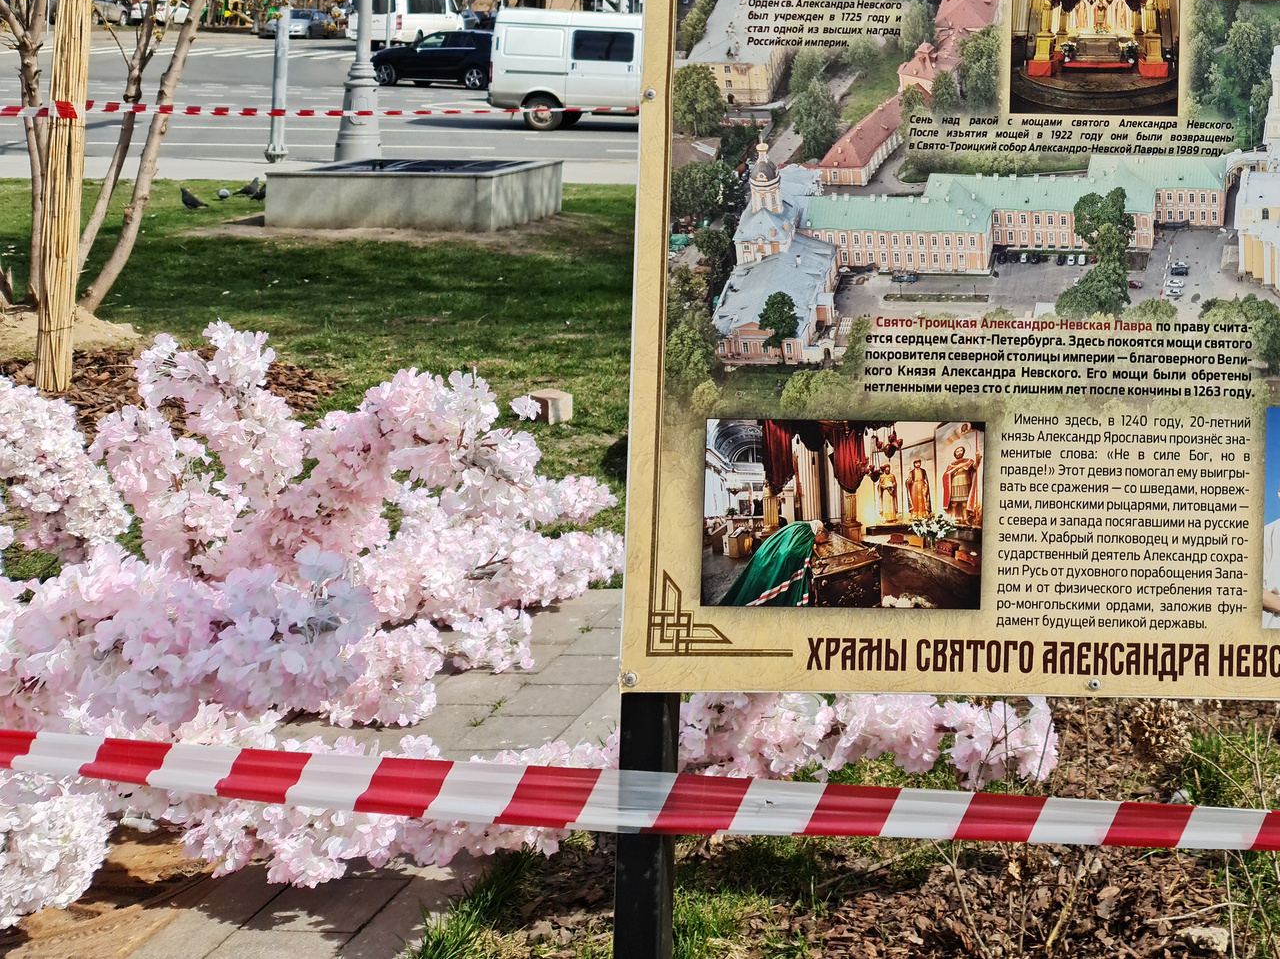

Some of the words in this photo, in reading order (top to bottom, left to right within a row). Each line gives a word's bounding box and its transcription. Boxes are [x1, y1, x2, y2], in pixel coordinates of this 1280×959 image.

[856, 0, 902, 10] Невского
[747, 10, 769, 20] был
[773, 12, 824, 23] учрежден
[828, 13, 835, 21] в
[841, 12, 862, 22] 1725
[866, 14, 890, 24] году
[747, 25, 770, 34] стал
[772, 23, 804, 35] одной
[807, 26, 819, 34] из
[822, 26, 863, 35] высших
[865, 27, 901, 37] наград
[746, 37, 803, 47] Российской
[908, 114, 933, 126] Сень
[941, 116, 960, 126] над
[968, 115, 999, 126] ракой
[1007, 117, 1013, 126] с
[1021, 118, 1062, 128] мощами
[1071, 119, 1110, 127] святого
[1118, 118, 1177, 130] Александра
[1186, 119, 1237, 130] Невского.
[875, 314, 977, 331] Свято-Троицкая
[980, 317, 1111, 332] Александро-Невская
[1113, 318, 1153, 333] Лавра
[1155, 322, 1171, 332] по
[1173, 322, 1211, 334] праву
[1213, 322, 1253, 335] счита-
[864, 334, 893, 344] ется
[894, 334, 948, 346] сердцем
[949, 332, 1066, 348] Санкт-Петербурга.
[1067, 334, 1105, 348] Здесь
[1106, 337, 1164, 347] покоятся
[1166, 338, 1202, 350] мощи
[1203, 339, 1252, 349] святого
[1014, 412, 1059, 425] Именно
[1064, 416, 1101, 427] здесь,
[1107, 416, 1115, 426] в
[1121, 414, 1147, 427] 1240
[1153, 417, 1183, 429] году,
[1189, 415, 1251, 428] 20-летний
[1000, 432, 1035, 442] князь
[1036, 430, 1101, 445] Александр
[1103, 431, 1167, 445] Ярославич
[1168, 433, 1223, 446] произнёс
[1224, 435, 1250, 445] зна-
[1000, 463, 1055, 477] правде!»
[1057, 463, 1085, 476] Этот
[1087, 466, 1122, 478] девиз
[1124, 467, 1174, 477] помогал
[1176, 468, 1198, 480] ему
[1200, 468, 1250, 480] выигры-
[806, 637, 907, 671] ХРАМЫ
[915, 638, 1034, 674] СВЯТОГО
[1042, 640, 1209, 682] АЛЕКСАНДРА
